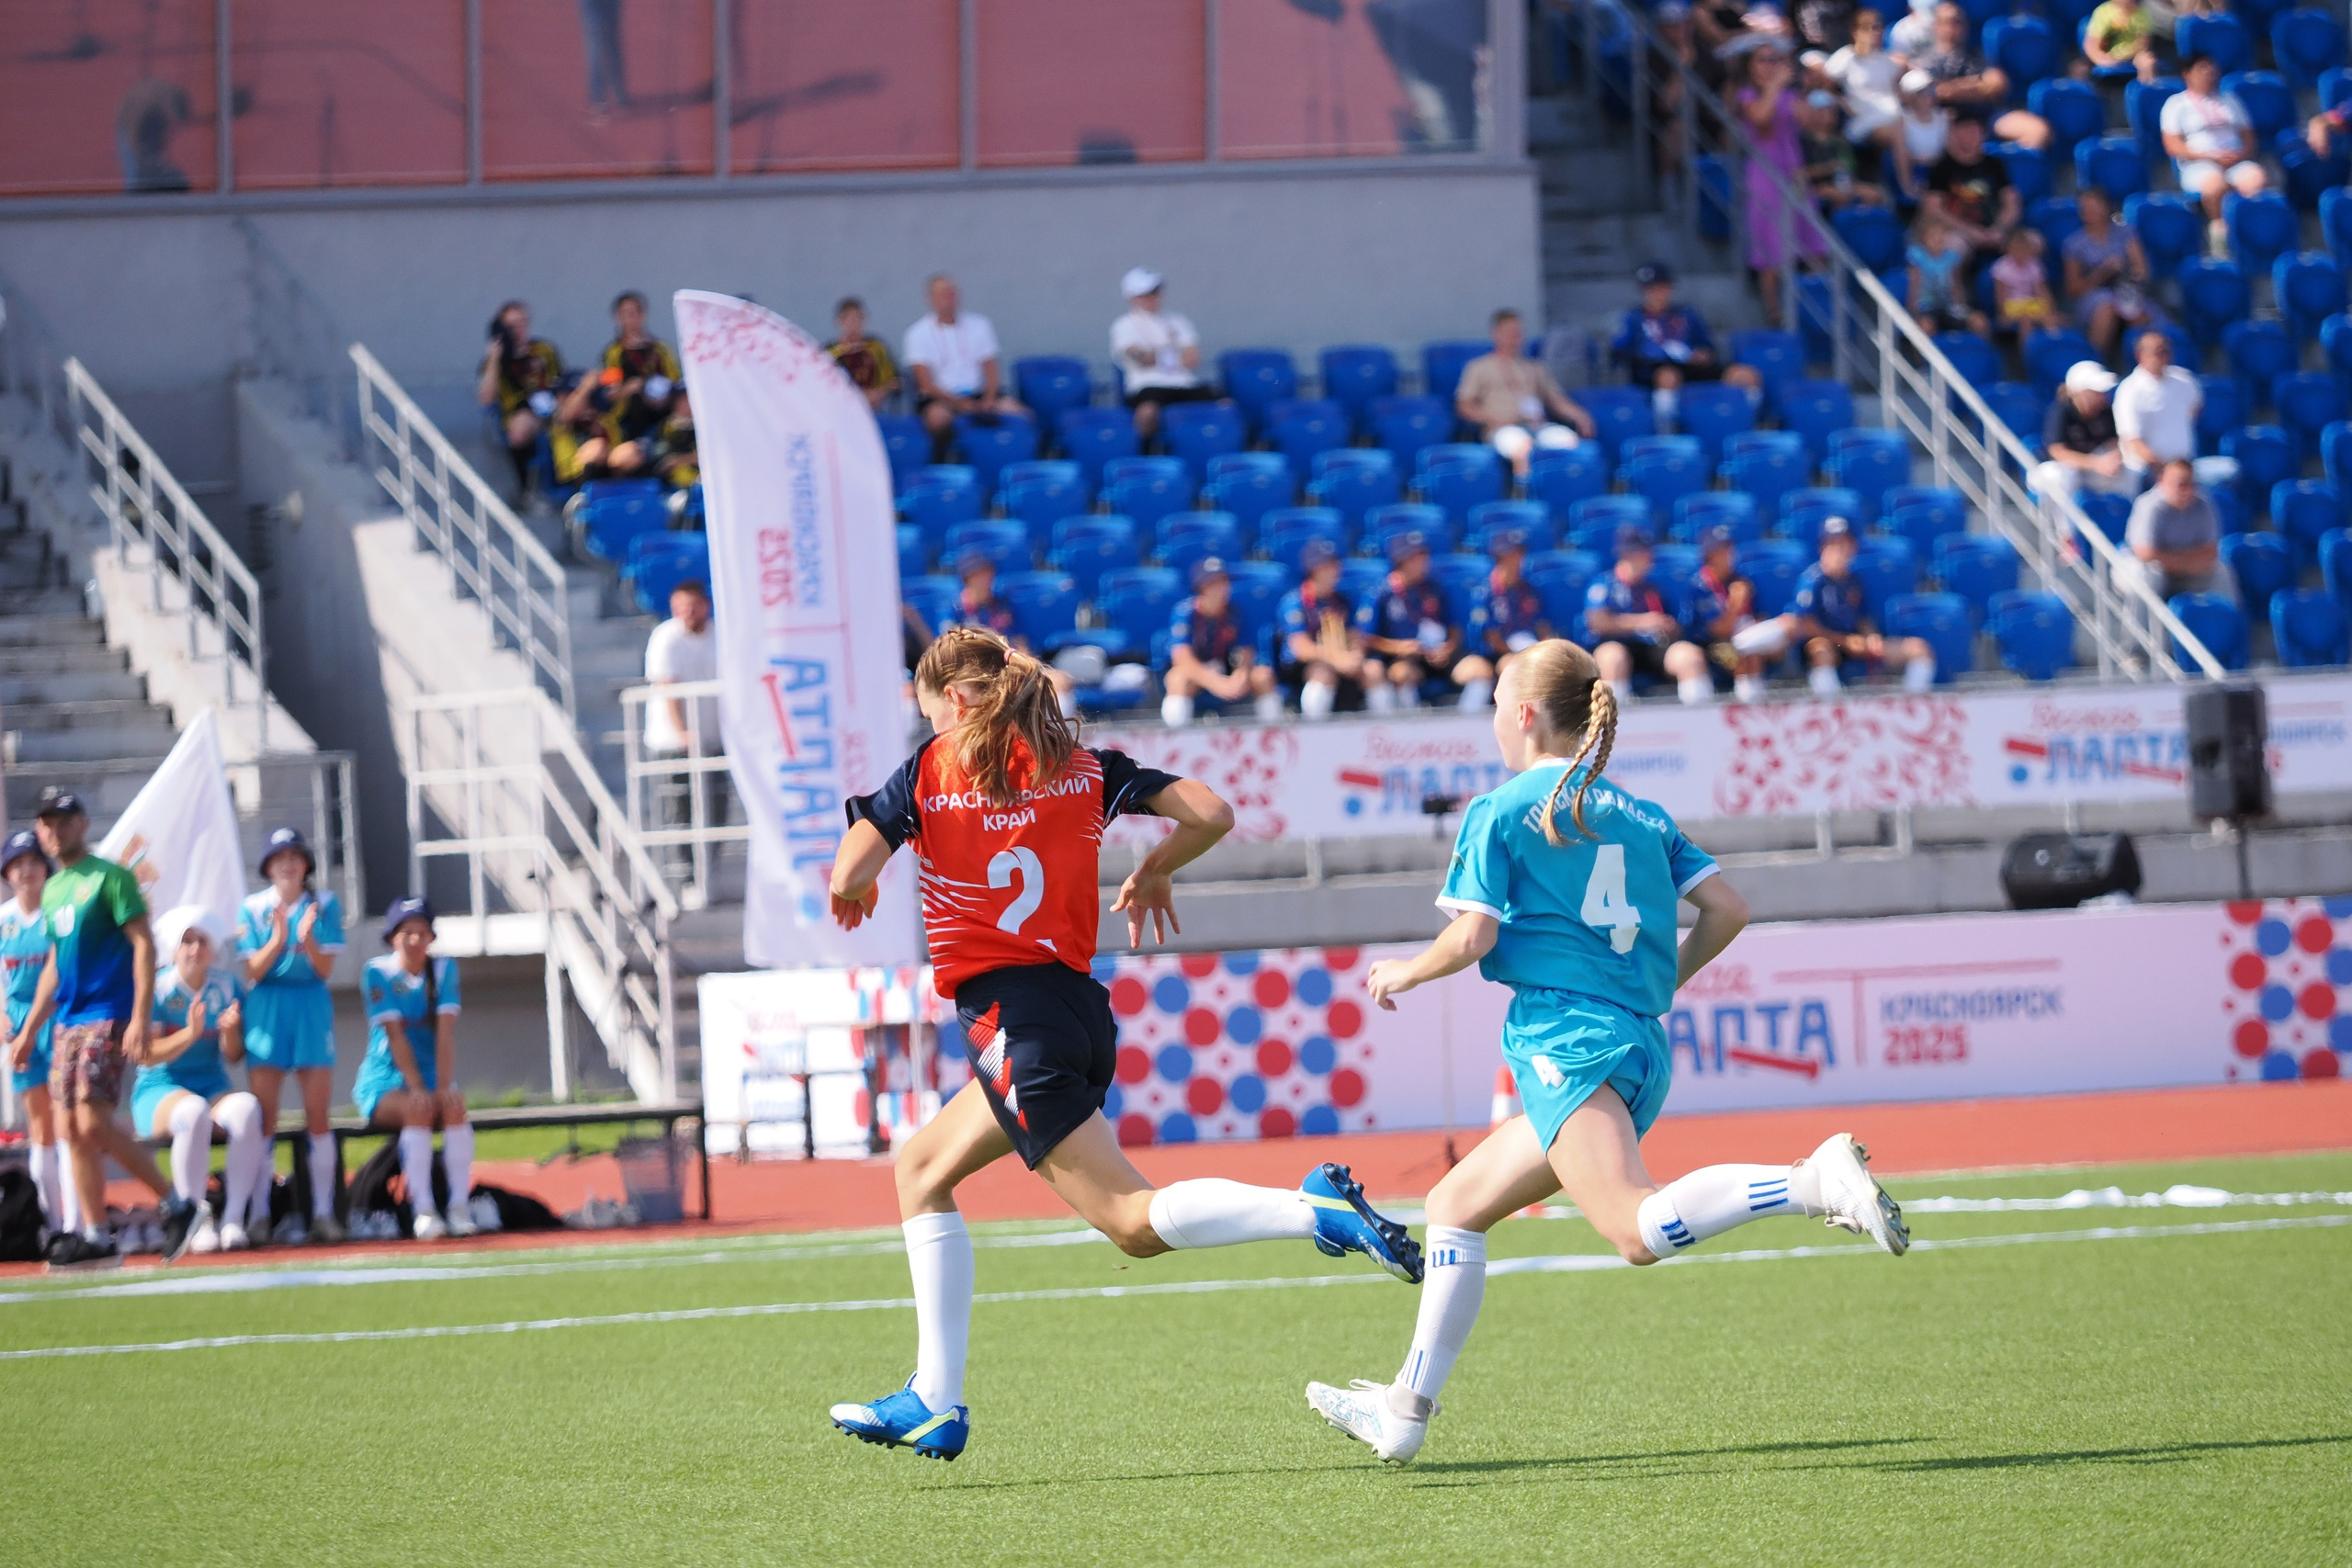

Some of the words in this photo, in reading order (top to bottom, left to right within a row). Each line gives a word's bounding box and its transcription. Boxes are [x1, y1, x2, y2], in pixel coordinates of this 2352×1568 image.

[982, 807, 1036, 831] КРАЙ
[1380, 762, 1518, 814] ЛАПТ
[987, 845, 1057, 953] 2
[1579, 843, 1642, 954] 4
[1670, 1001, 1836, 1073] АПТА
